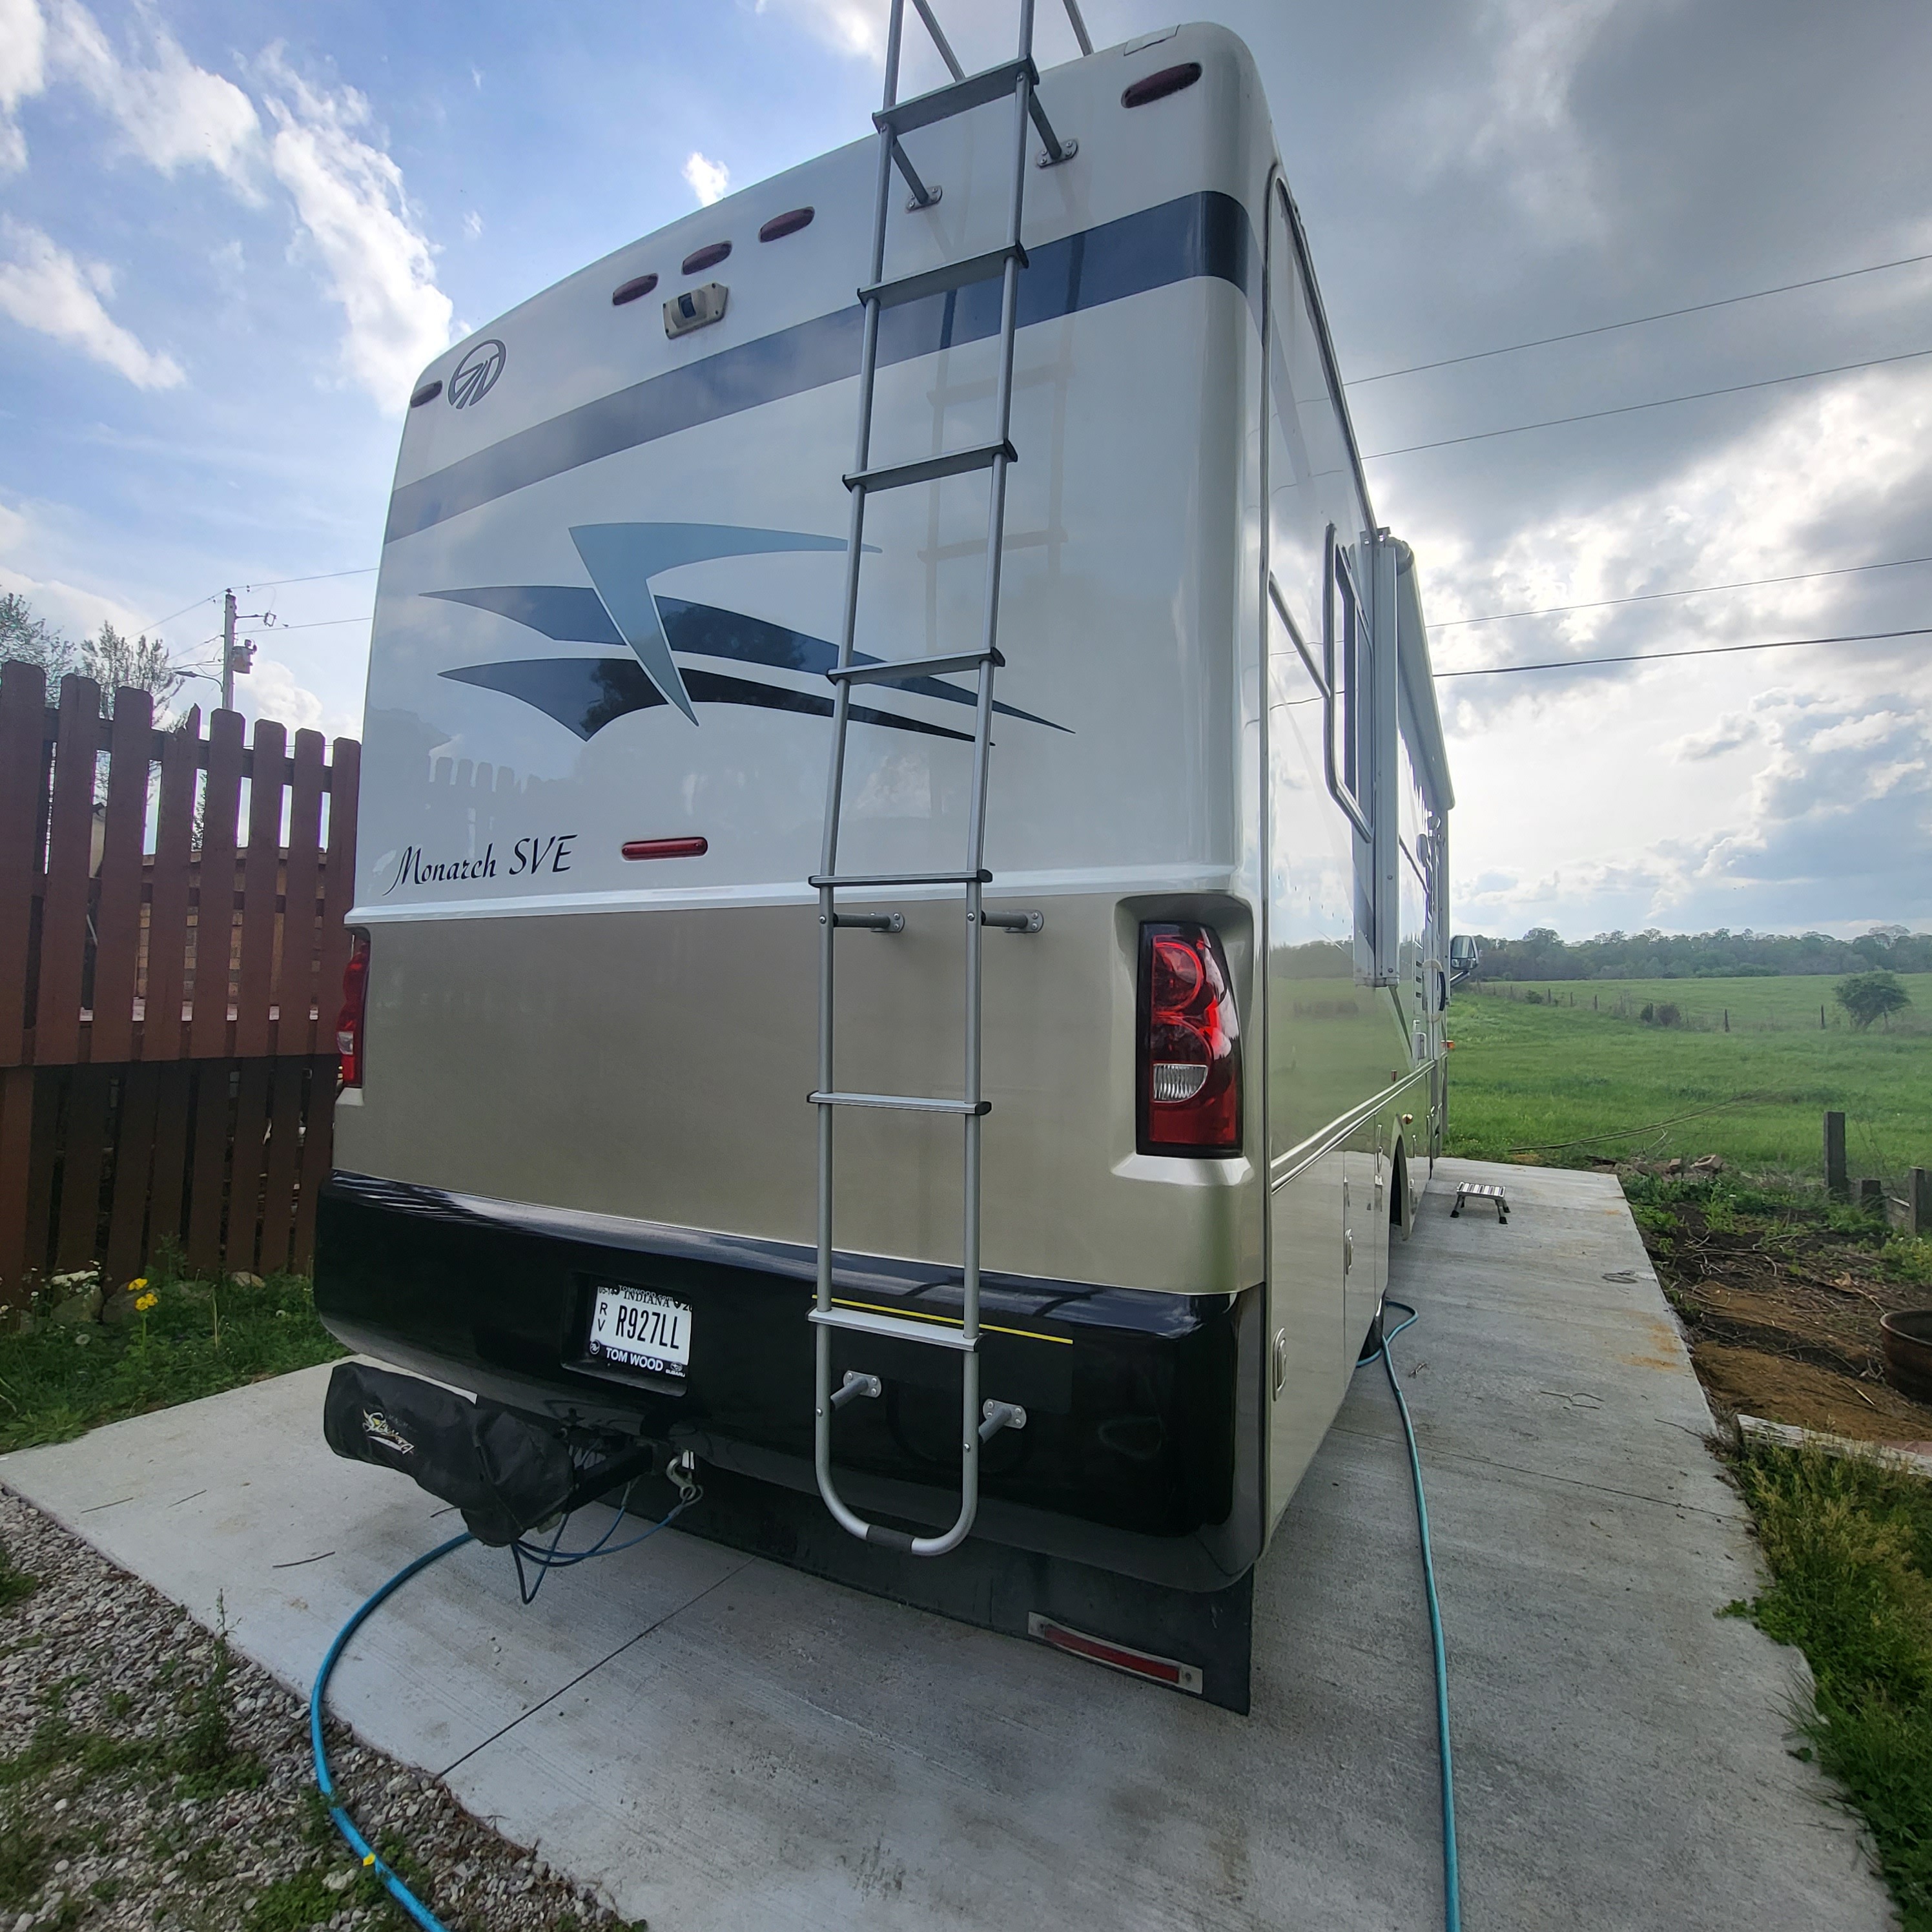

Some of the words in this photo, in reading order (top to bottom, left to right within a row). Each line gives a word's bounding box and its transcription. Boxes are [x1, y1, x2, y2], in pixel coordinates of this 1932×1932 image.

[382, 842, 497, 896] Monarch
[509, 834, 578, 874] SVE
[623, 1291, 670, 1308] INDIANA
[615, 1305, 679, 1350] R927LL
[606, 1348, 627, 1363] TOM
[630, 1353, 664, 1372] WOOD
